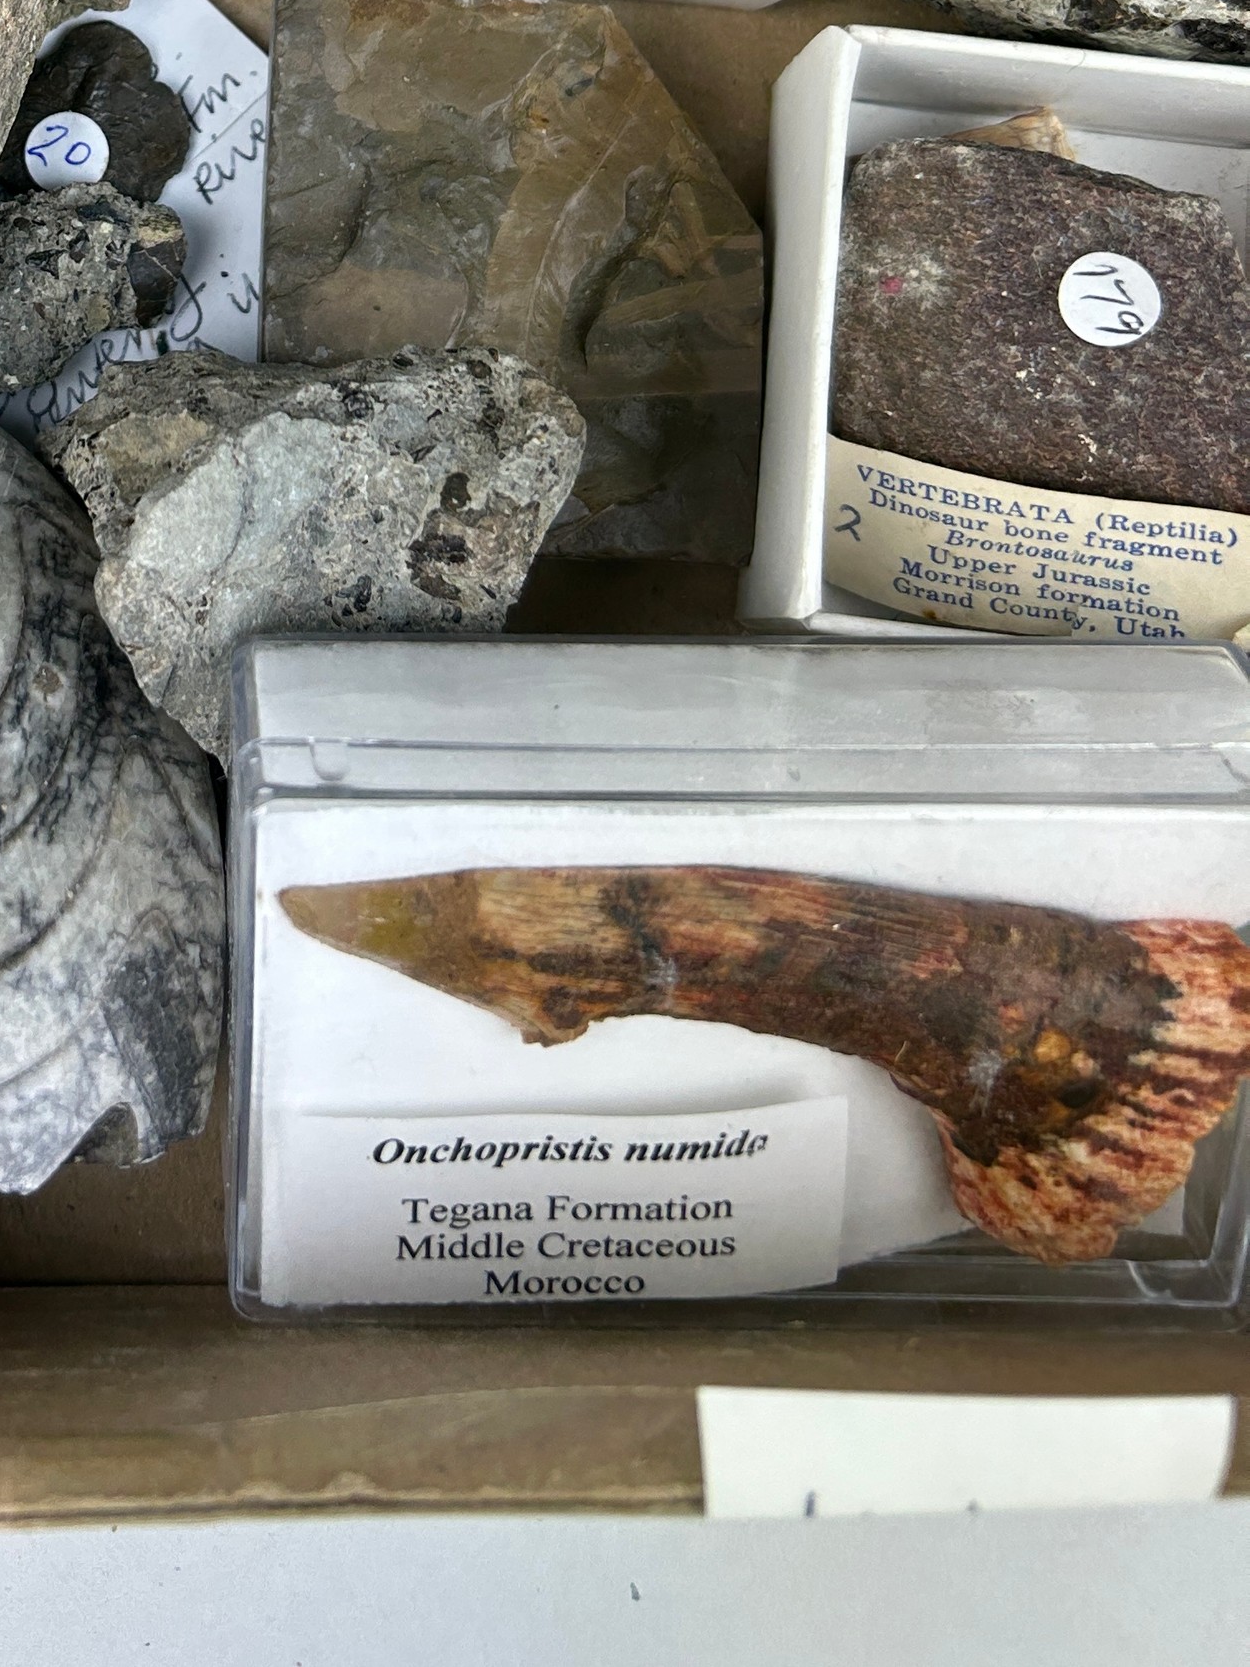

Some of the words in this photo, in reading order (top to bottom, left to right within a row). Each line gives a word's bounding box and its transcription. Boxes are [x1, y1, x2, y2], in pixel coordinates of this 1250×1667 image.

[27, 124, 91, 167] 20
[834, 504, 862, 541] 2
[856, 465, 1074, 524] VERTEBRATA
[1095, 513, 1238, 548] (Reptilia)
[868, 488, 989, 533] Dinosaur
[1004, 519, 1069, 544] bone
[1085, 532, 1223, 566] fragment
[927, 545, 1016, 579] Upper
[1032, 563, 1151, 597] Jurassic
[945, 530, 1134, 573] Brontosaurus
[893, 578, 974, 609] Grand
[901, 557, 1021, 597] Morrison
[1037, 584, 1180, 622] formation
[372, 1135, 613, 1168] Onchopristis
[401, 1197, 533, 1229] Tegana
[547, 1194, 733, 1221] Formation
[395, 1233, 524, 1260] Middle
[536, 1232, 736, 1259] Cretaceous
[483, 1269, 646, 1295] Morocco
